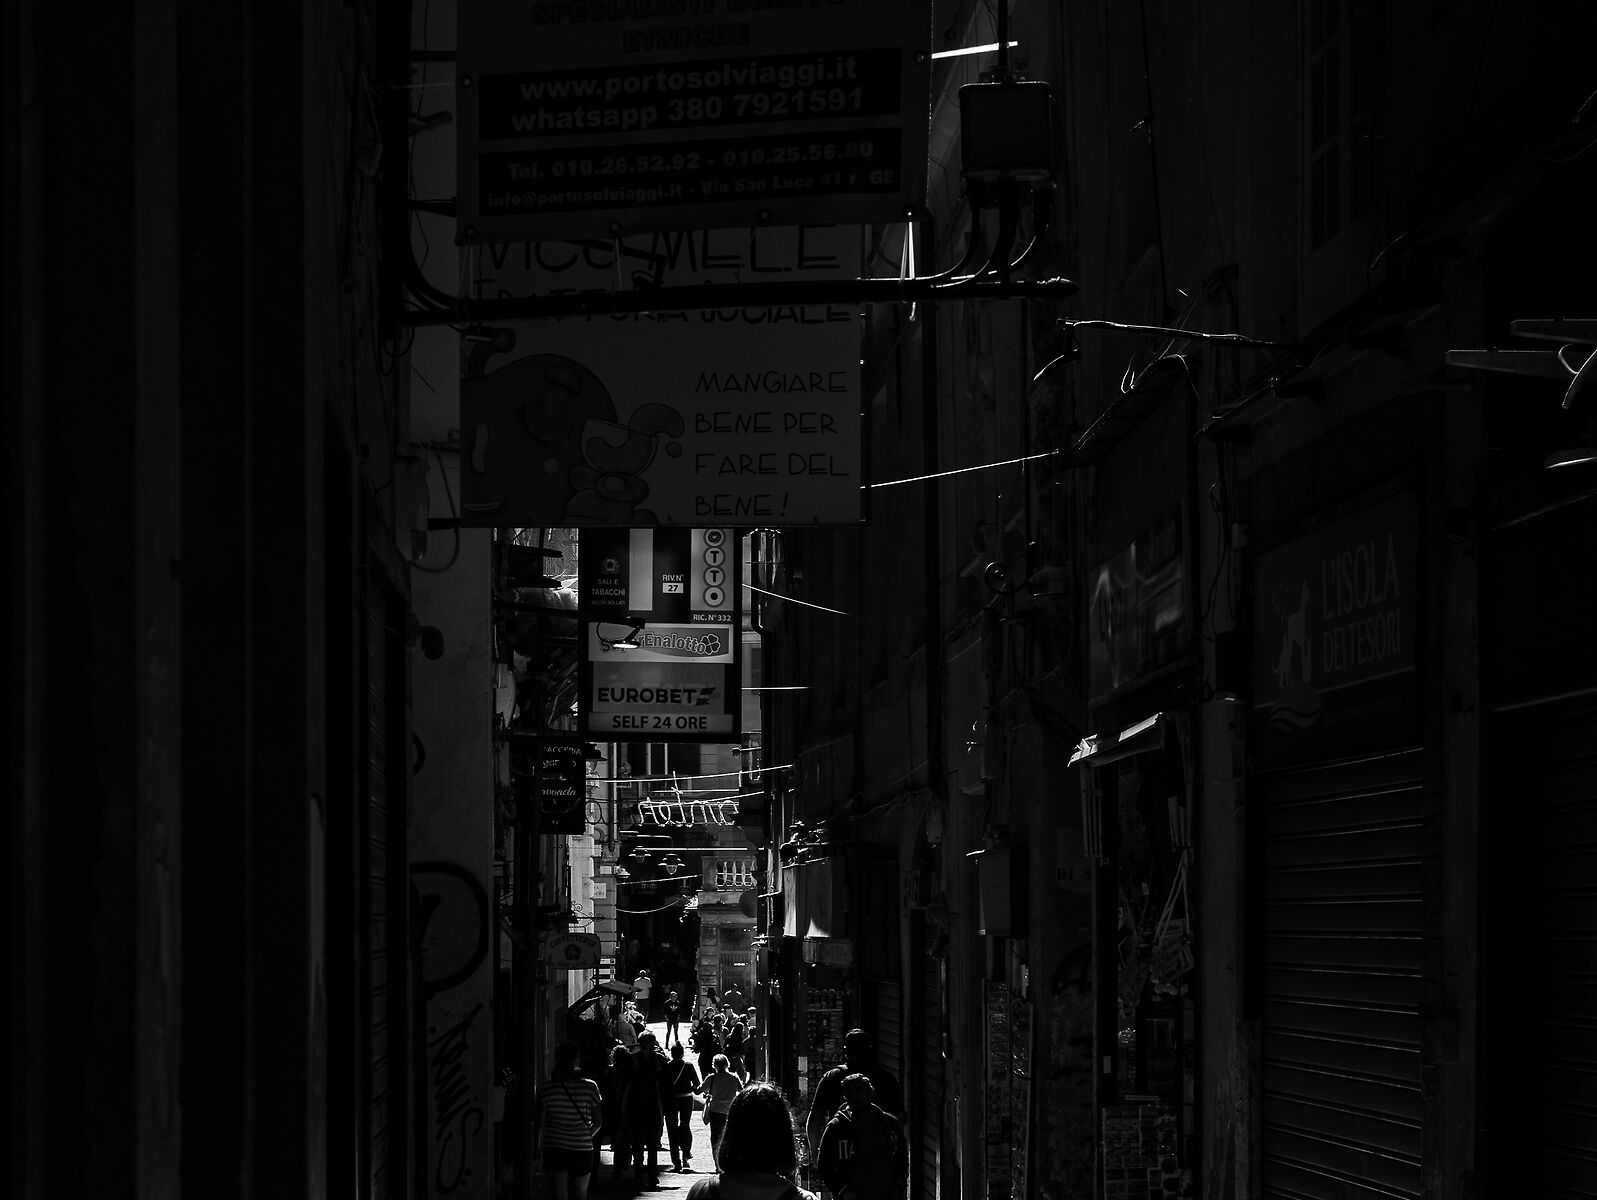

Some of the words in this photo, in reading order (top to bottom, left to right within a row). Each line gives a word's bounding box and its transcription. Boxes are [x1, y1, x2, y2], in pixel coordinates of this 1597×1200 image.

[622, 22, 750, 53] ETNICHE
[519, 56, 858, 101] www.portosolviaggi.it
[511, 103, 659, 132] whatsapp
[668, 96, 722, 122] 380
[733, 86, 864, 117] 7921591
[507, 161, 546, 181] Tel.
[551, 152, 701, 177] 010.26.52.92
[722, 141, 874, 168] 010.25.56.80
[487, 183, 684, 209] info@portosolviaggi.it
[699, 178, 729, 196] Via
[733, 176, 768, 193] San
[771, 173, 815, 191] Luca
[870, 169, 896, 185] GE
[695, 370, 848, 394] MANGIARE
[695, 411, 773, 434] BENE
[783, 411, 838, 434] PER
[695, 452, 779, 476] FARE
[788, 452, 849, 477] DEL
[667, 584, 679, 592] 27
[1321, 530, 1401, 622] L'ISOLA
[591, 588, 626, 597] TABACCHI
[692, 613, 707, 622] RIC.
[717, 613, 732, 622] 332
[1322, 625, 1346, 675] DEI
[1346, 607, 1401, 668] TESORI
[597, 686, 697, 705] EUROBET
[612, 714, 650, 730] SELF
[652, 715, 672, 730] 24
[675, 715, 708, 730] ORE
